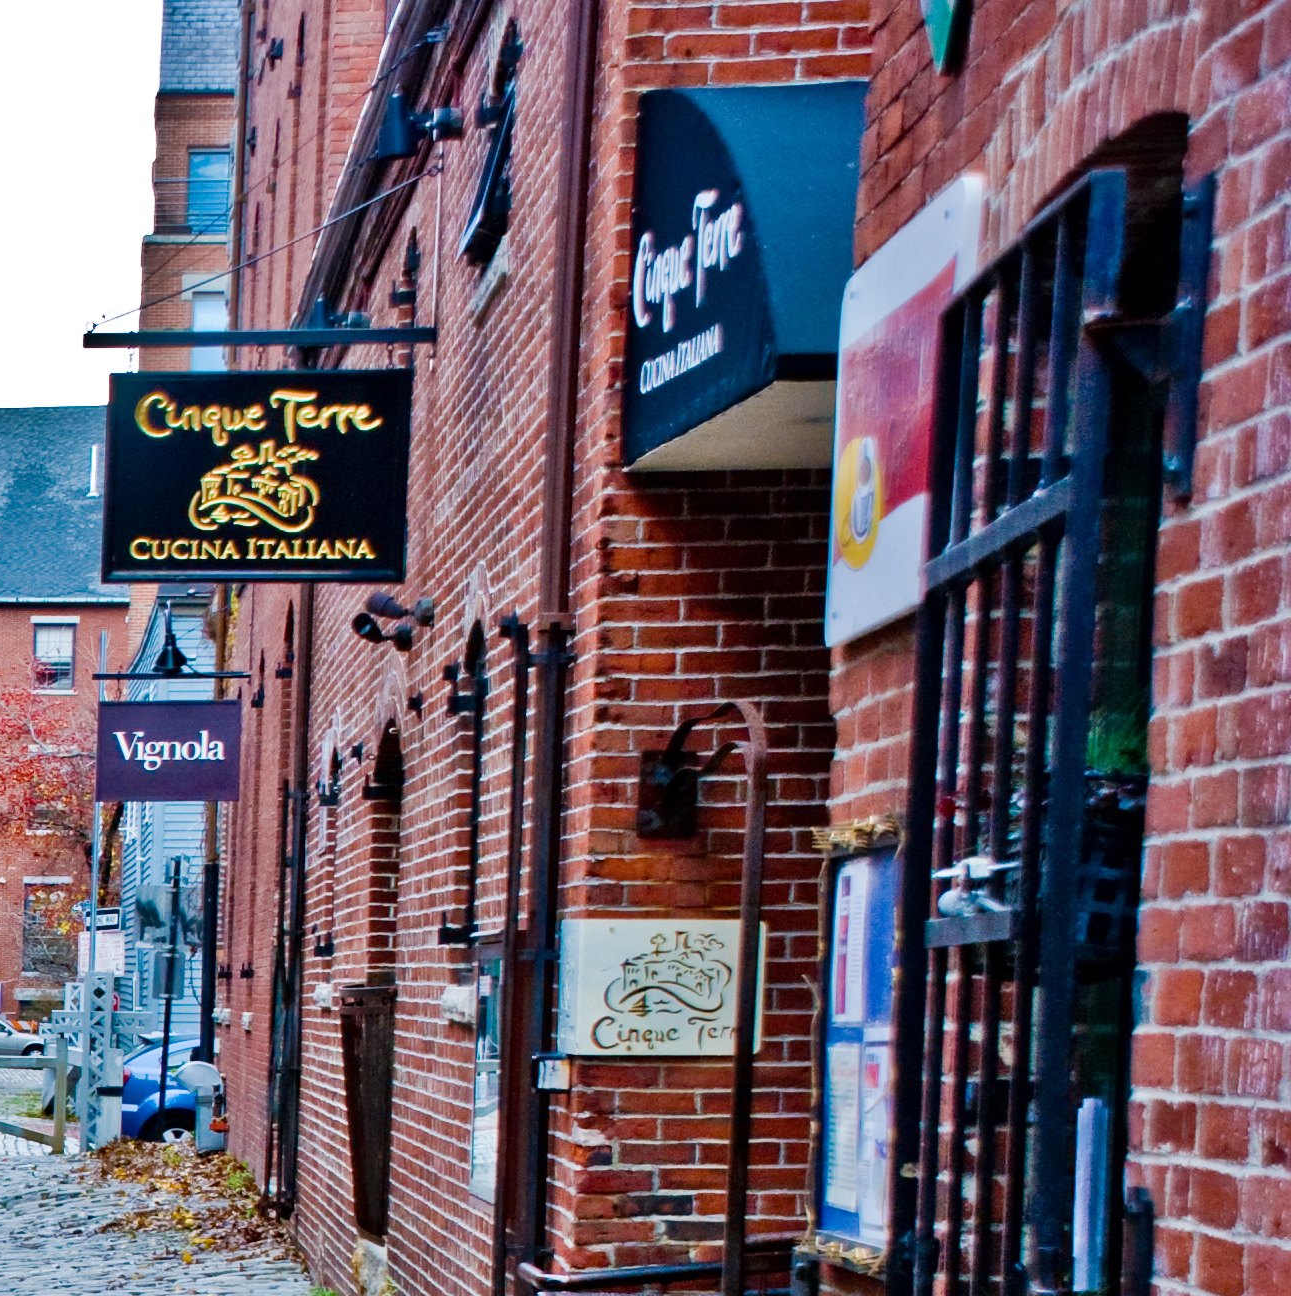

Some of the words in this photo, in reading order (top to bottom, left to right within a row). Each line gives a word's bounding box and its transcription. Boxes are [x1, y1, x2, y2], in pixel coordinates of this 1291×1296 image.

[632, 230, 695, 334] Cinque
[692, 187, 744, 309] Terre
[639, 350, 677, 395] CUCINA
[675, 322, 724, 377] ITALIANA
[134, 391, 268, 447] Cinque
[269, 388, 384, 444] Terre
[129, 536, 241, 560] CUCINA
[245, 536, 376, 560] ITALIANA
[112, 729, 226, 771] Vignola
[590, 1015, 681, 1050] Cinque
[687, 1016, 736, 1050] Terr
